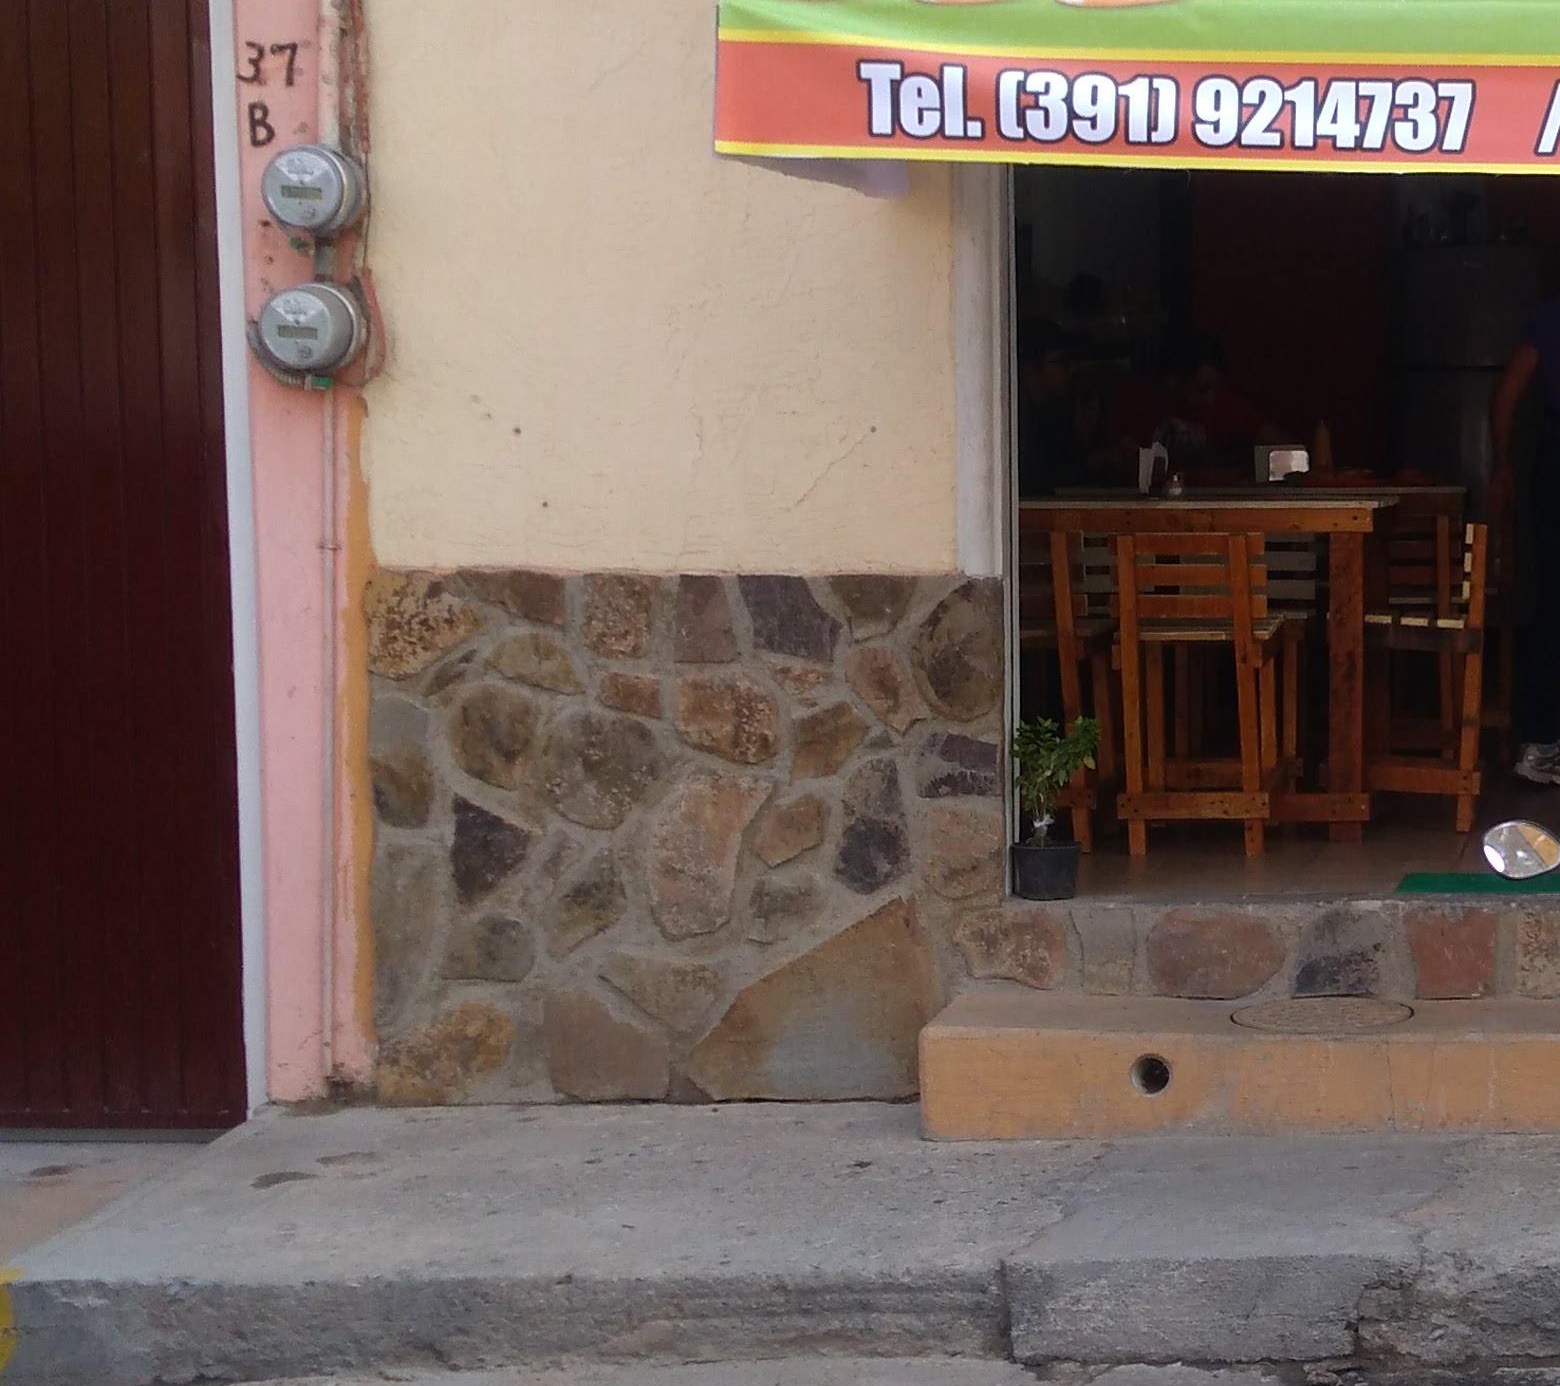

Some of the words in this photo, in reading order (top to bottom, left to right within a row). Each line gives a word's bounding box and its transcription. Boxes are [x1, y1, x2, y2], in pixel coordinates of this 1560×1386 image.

[236, 41, 299, 87] 37
[247, 101, 276, 148] B
[858, 60, 983, 139] Tel.
[1000, 70, 1177, 145] (391)
[1193, 77, 1476, 154] 9214737
